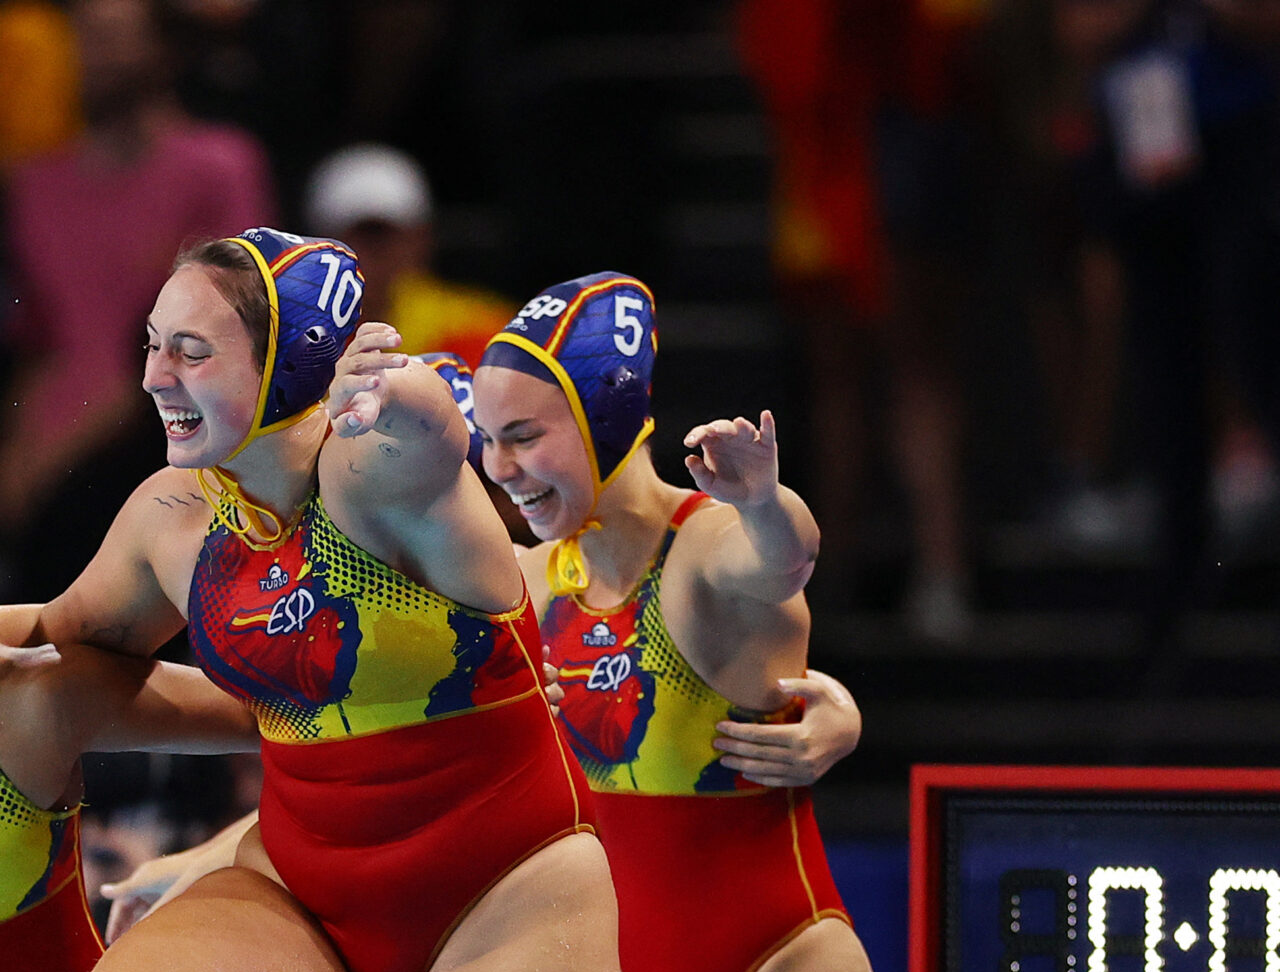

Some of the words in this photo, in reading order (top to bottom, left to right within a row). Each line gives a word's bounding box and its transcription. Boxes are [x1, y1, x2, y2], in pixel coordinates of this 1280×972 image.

[317, 253, 362, 328] 10
[518, 295, 567, 320] SP
[613, 295, 643, 357] 5
[260, 573, 289, 591] TURBO
[267, 588, 315, 635] ESP
[582, 633, 617, 646] TURBO
[587, 653, 631, 690] ESP
